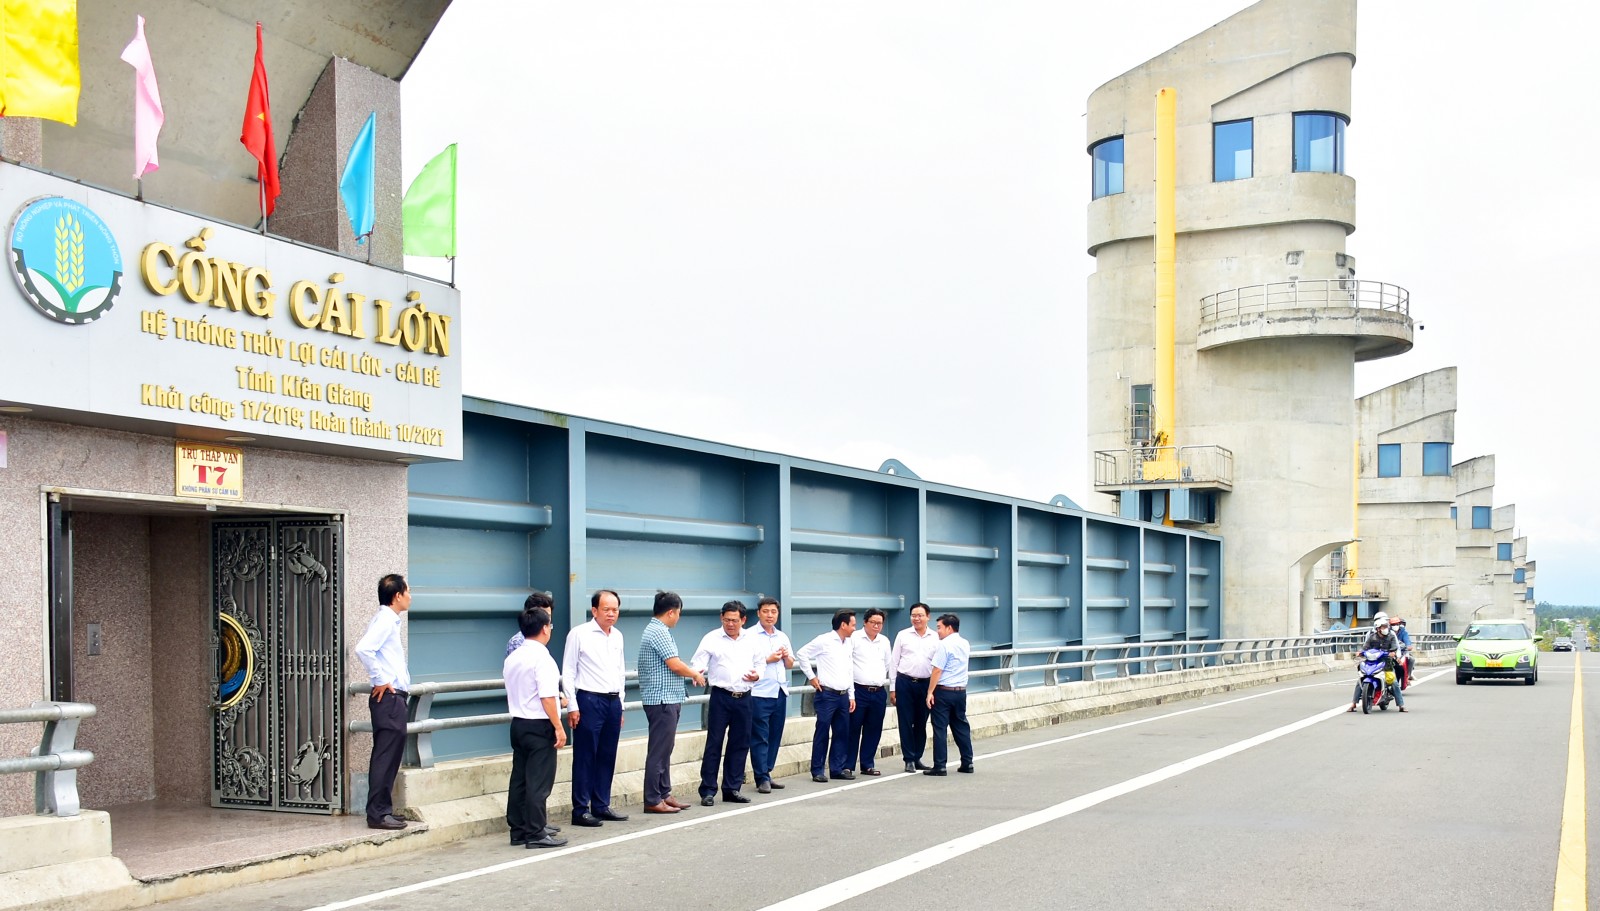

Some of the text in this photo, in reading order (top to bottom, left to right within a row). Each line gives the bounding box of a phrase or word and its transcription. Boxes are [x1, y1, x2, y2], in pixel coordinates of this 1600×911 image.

[140, 227, 452, 357] CỐNG CÁI LỚN
[141, 309, 168, 340] HỆ
[172, 314, 237, 349] THỐNG
[241, 330, 286, 359] THỦY
[290, 341, 316, 367] LỢI
[320, 345, 347, 370] CÁI
[351, 351, 382, 377] LỚN
[396, 361, 421, 384] CÁI
[423, 366, 441, 388] BÉ
[141, 383, 185, 411] Khởi
[189, 392, 236, 421] công:
[241, 399, 305, 430] 11/2019;
[310, 409, 348, 433] Hoàn
[396, 423, 445, 447] 10/2021
[235, 365, 374, 412] Tỉnh Kiên Giang
[193, 464, 228, 486] T7
